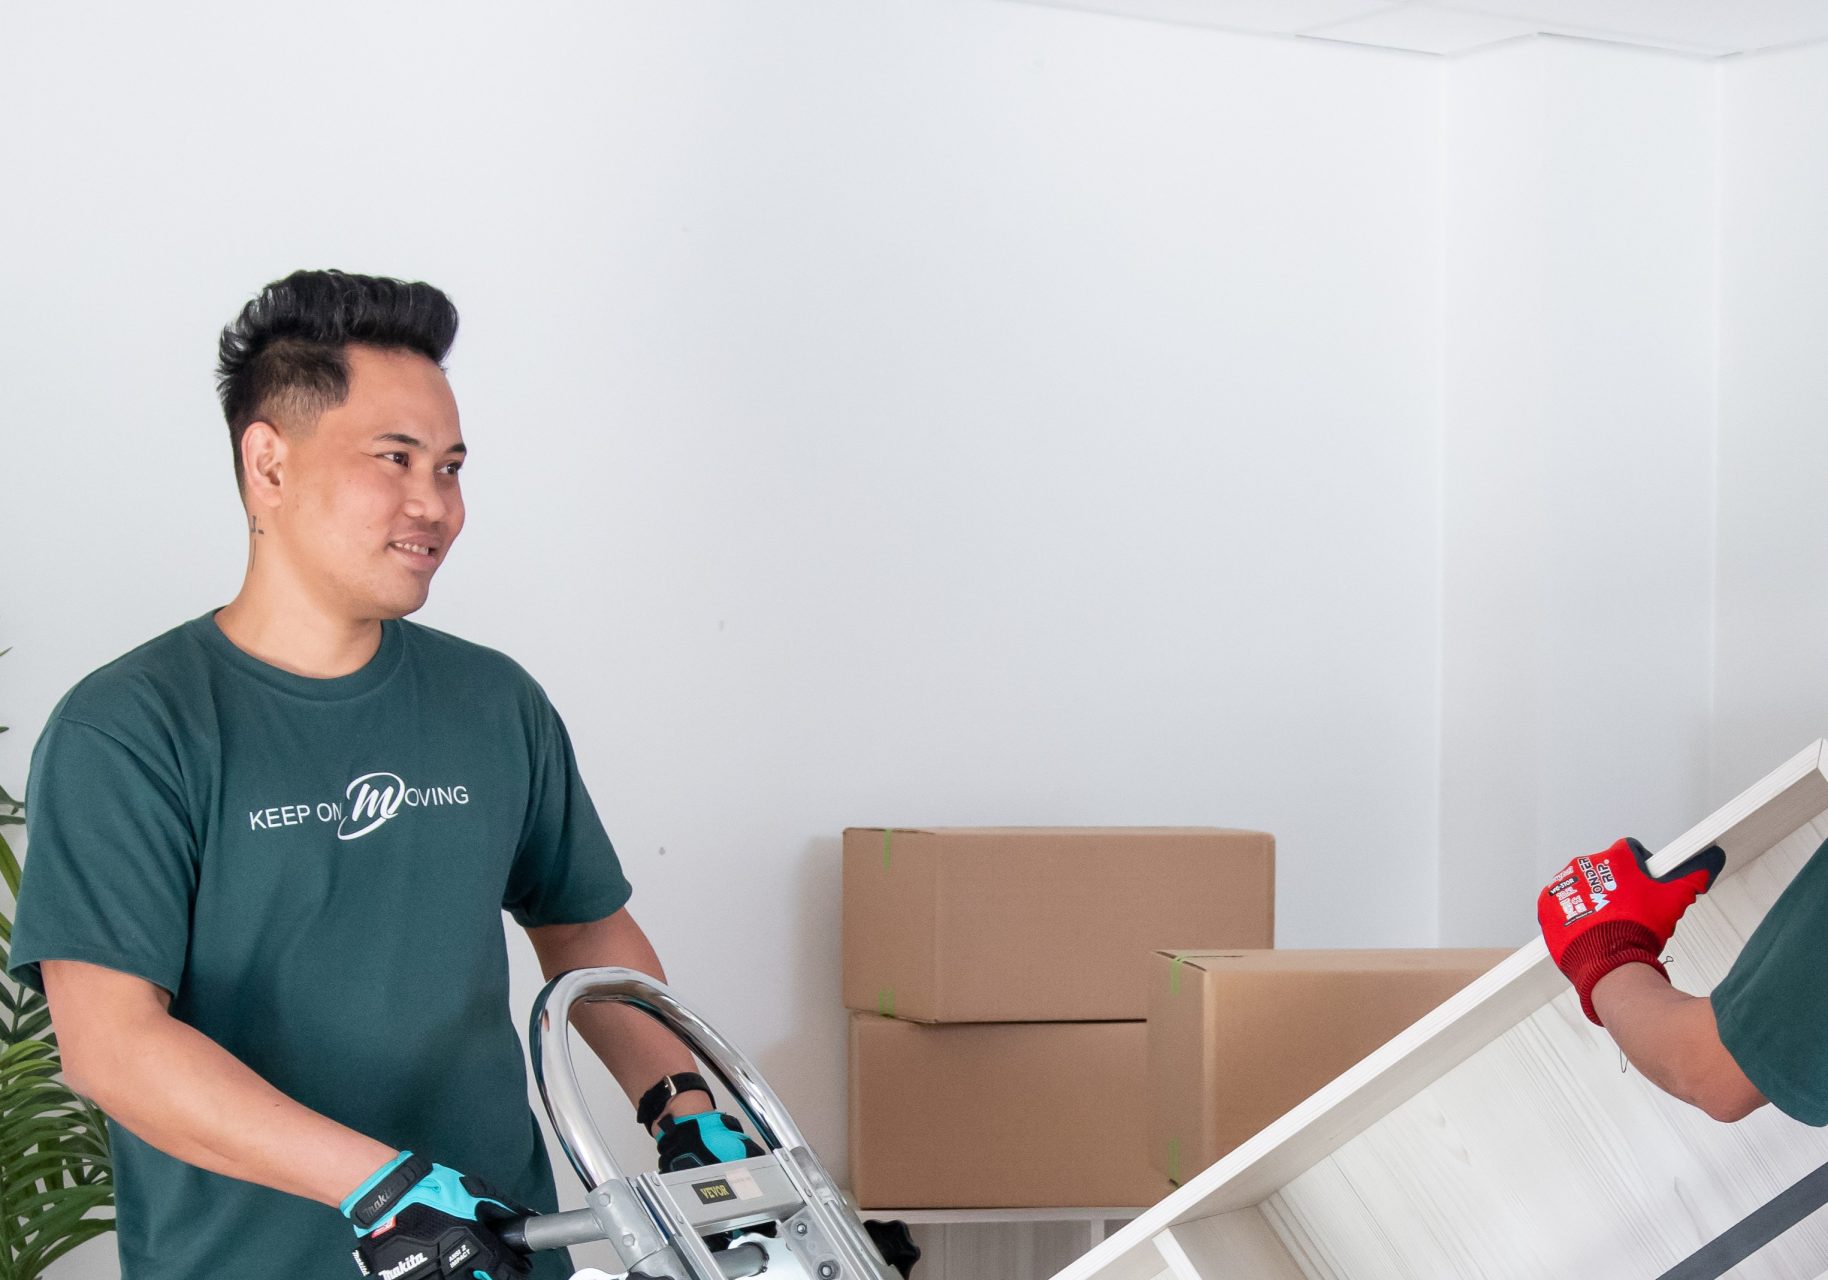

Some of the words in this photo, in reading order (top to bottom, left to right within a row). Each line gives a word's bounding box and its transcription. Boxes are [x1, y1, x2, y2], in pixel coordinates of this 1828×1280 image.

[249, 804, 311, 831] KEEP
[316, 802, 342, 822] ON
[1577, 857, 1611, 912] WONDER
[700, 1184, 730, 1199] VEVOR
[449, 1248, 470, 1268] IMPACT
